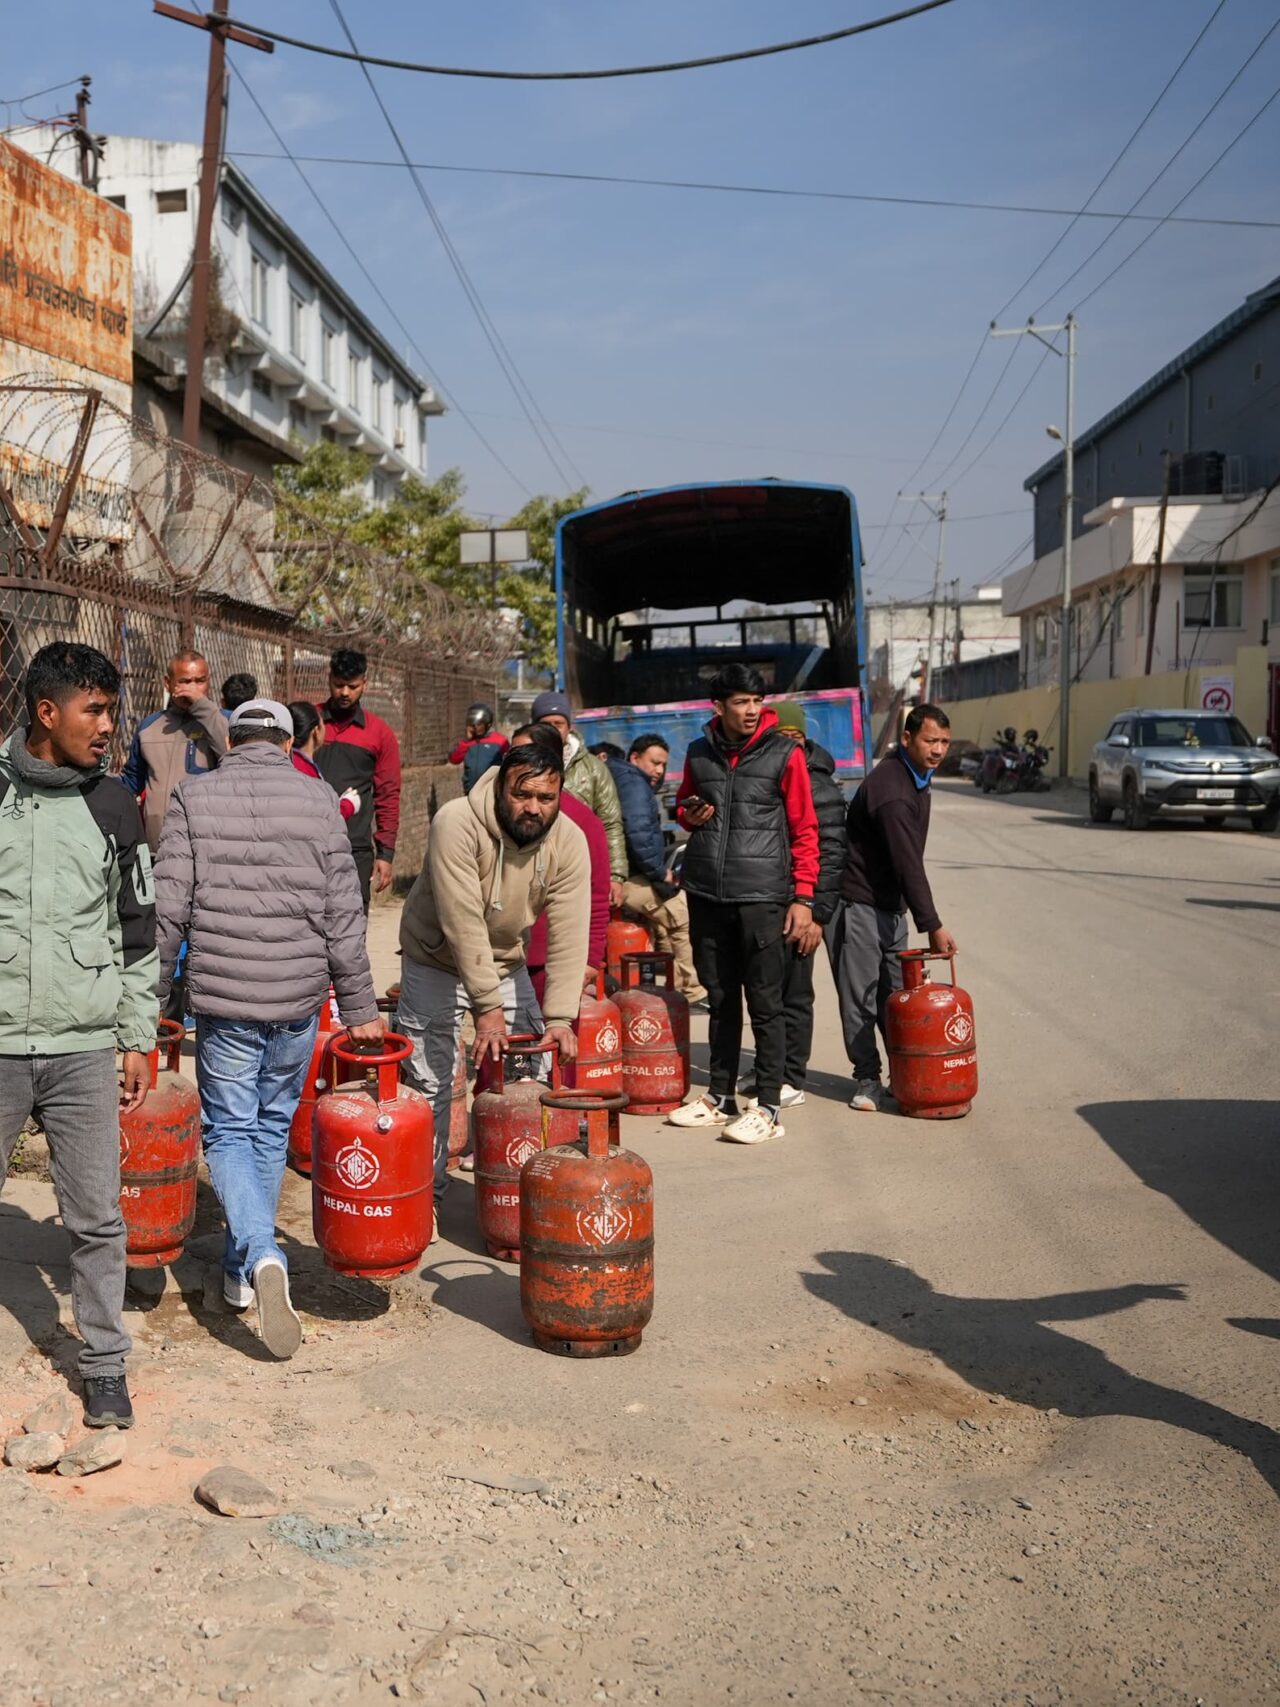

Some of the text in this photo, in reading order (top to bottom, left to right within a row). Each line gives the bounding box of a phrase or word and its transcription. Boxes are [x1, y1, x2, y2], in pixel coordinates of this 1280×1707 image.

[586, 1067, 613, 1079] NEPAL
[654, 1066, 676, 1076] GAS
[120, 1185, 140, 1198] AS
[323, 1195, 393, 1217] NEPAL GAS
[492, 1194, 520, 1207] NEP
